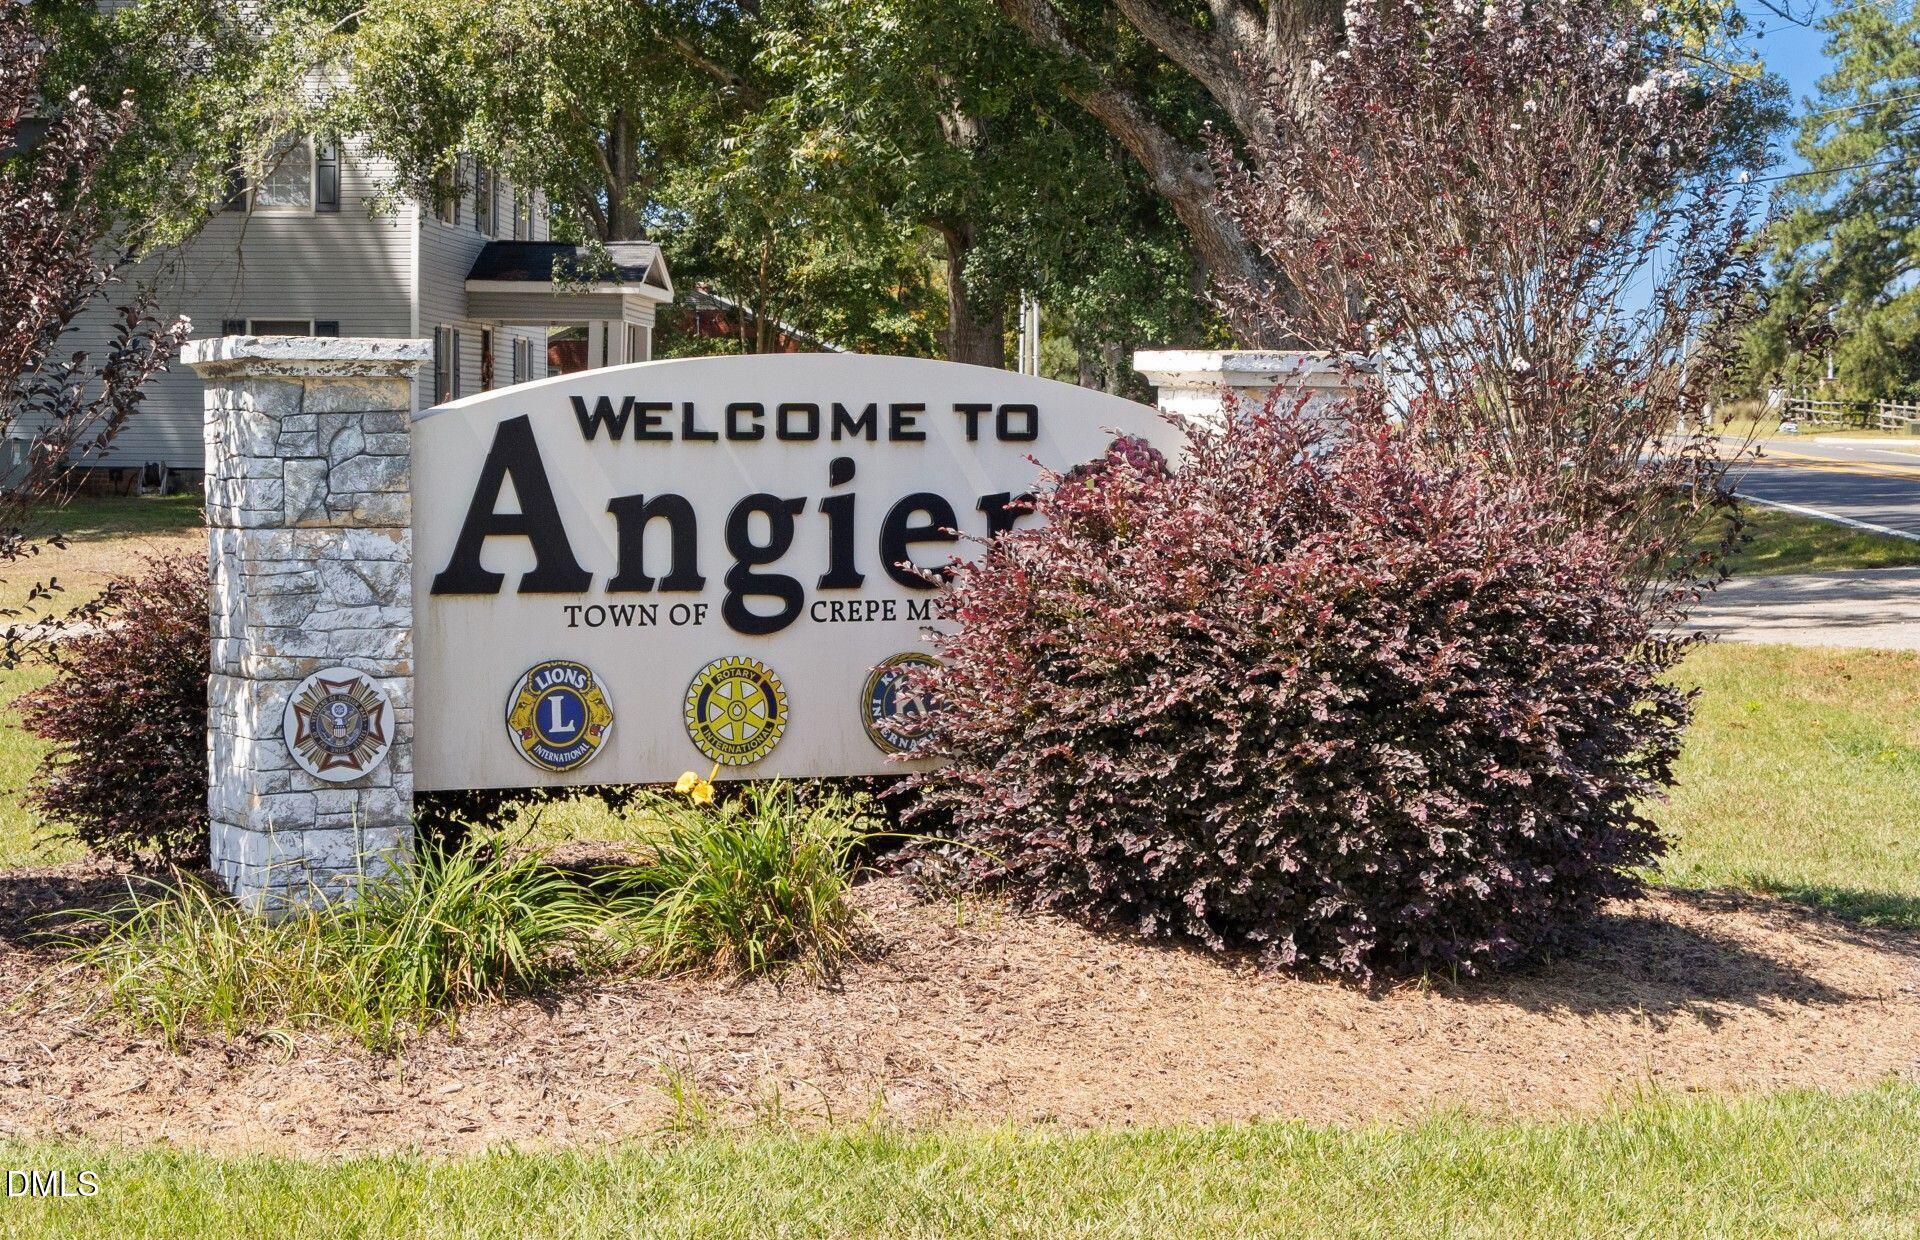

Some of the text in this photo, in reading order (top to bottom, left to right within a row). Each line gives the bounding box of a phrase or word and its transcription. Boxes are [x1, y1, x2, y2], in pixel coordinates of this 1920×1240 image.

[568, 395, 1039, 442] WELCOME TO
[564, 603, 709, 628] TOWN OF
[810, 599, 897, 623] CREPE
[534, 667, 587, 691] LIONS
[715, 668, 757, 683] ROTARY
[547, 695, 576, 734] L
[703, 725, 773, 754] INTERNATIONAL
[533, 742, 591, 763] INTERNATIONAL
